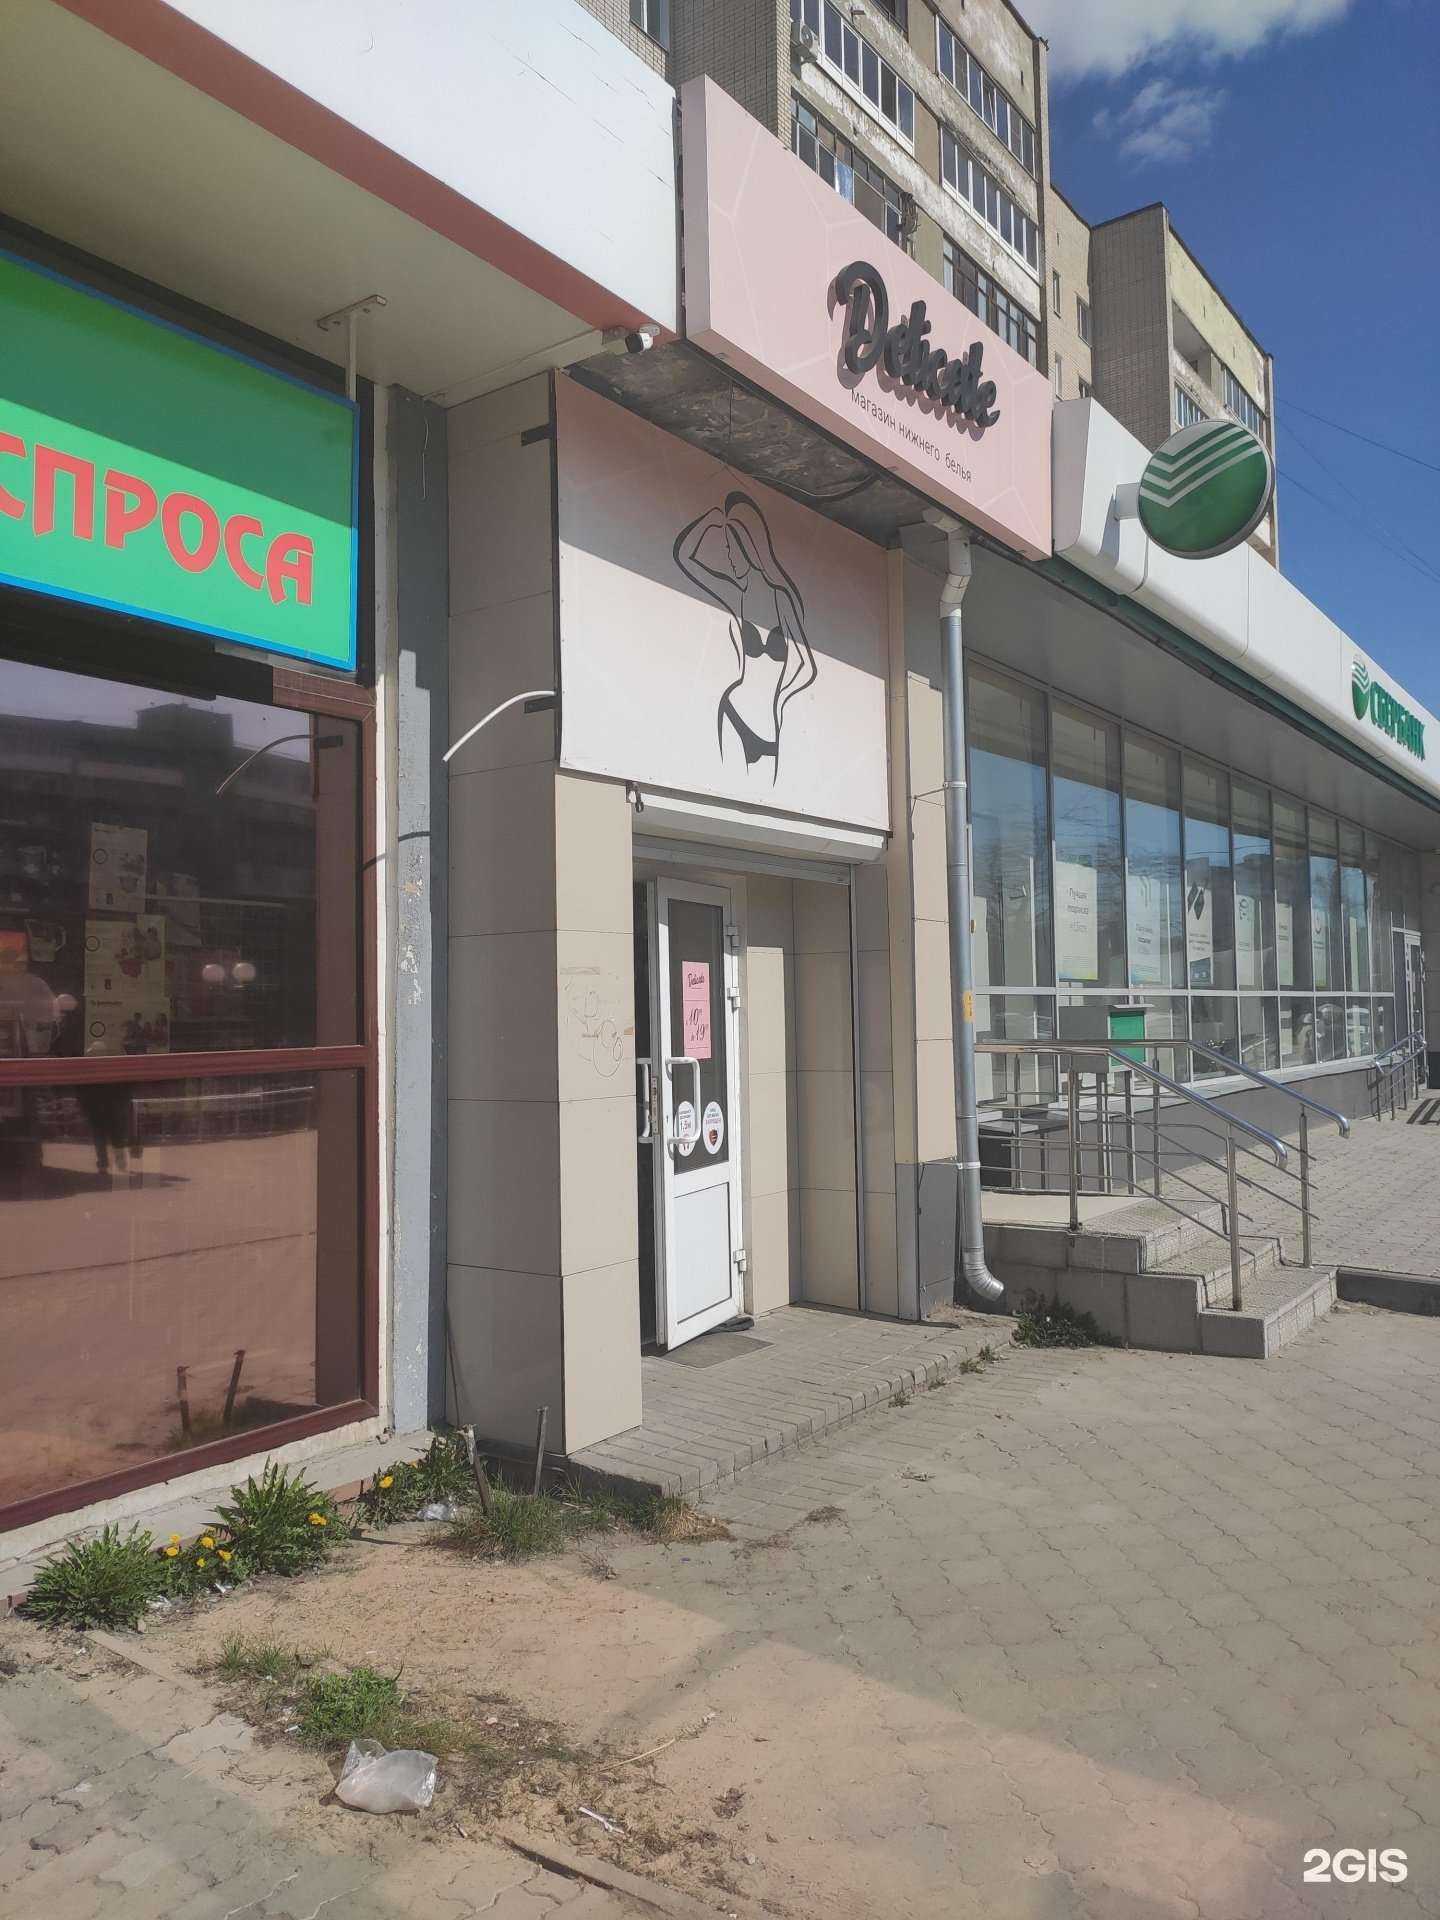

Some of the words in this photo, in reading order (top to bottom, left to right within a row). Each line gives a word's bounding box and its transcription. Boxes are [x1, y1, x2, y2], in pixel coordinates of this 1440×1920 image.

[835, 261, 1000, 428] Delicate
[851, 387, 896, 431] магазин
[899, 421, 941, 461] нижнего
[945, 452, 972, 482] белья
